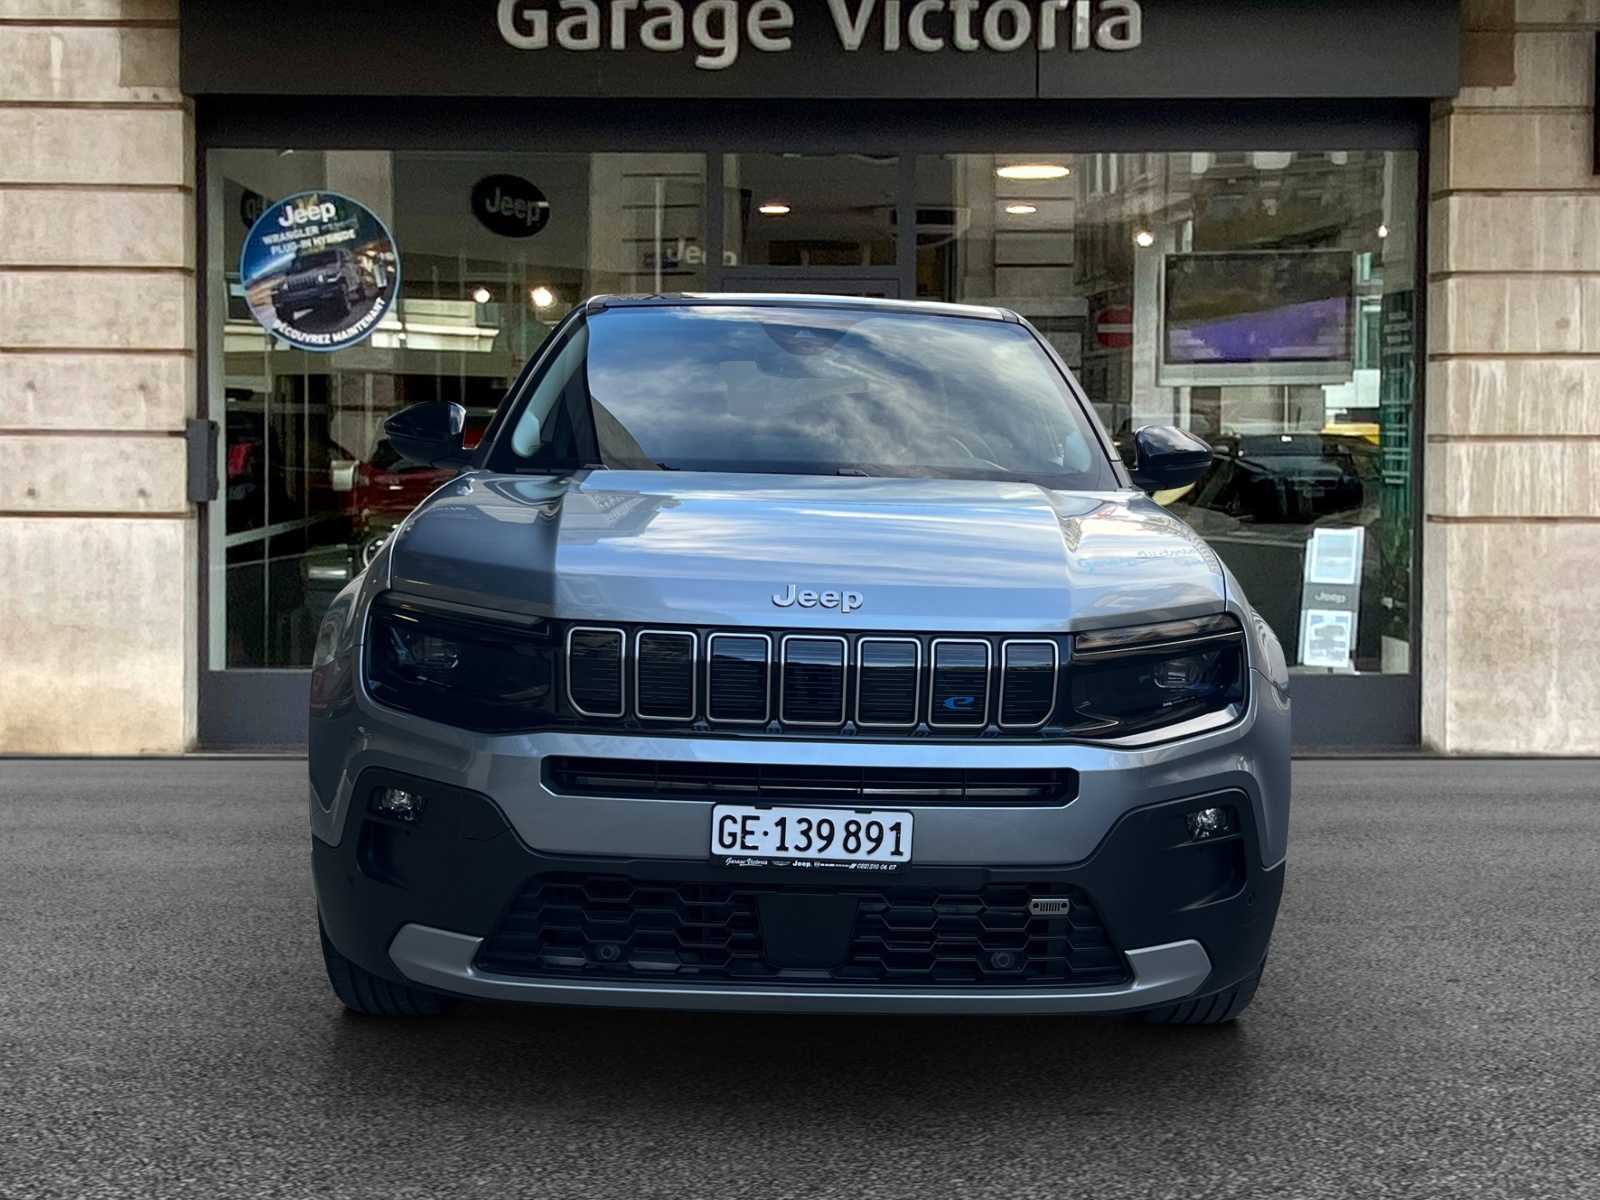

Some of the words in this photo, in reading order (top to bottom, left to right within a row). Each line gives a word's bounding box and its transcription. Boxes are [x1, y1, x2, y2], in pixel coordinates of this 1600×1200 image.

[497, 0, 794, 70] Garage
[827, 0, 1142, 52] Victoria
[278, 202, 336, 227] Jeep
[485, 186, 540, 226] Jeep
[262, 225, 319, 245] WRANGLER
[666, 239, 737, 266] Jep
[332, 296, 386, 342] MAINTENANT
[771, 584, 864, 613] Jeep
